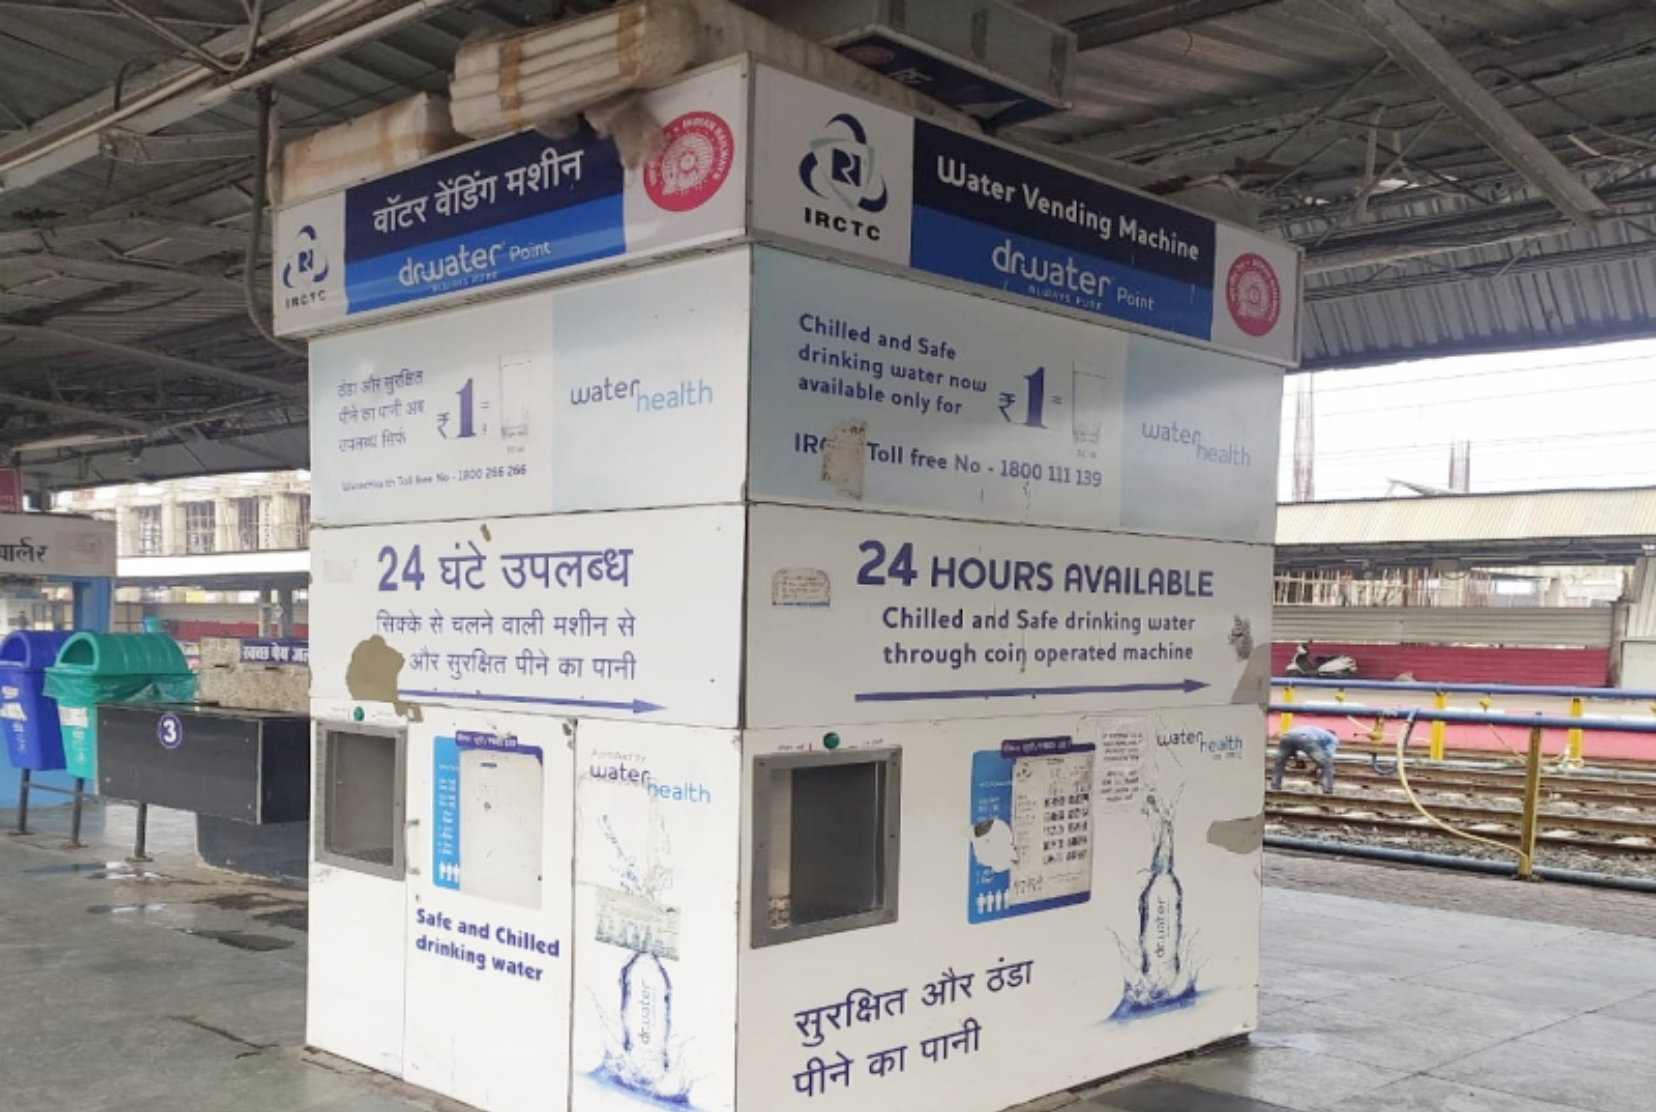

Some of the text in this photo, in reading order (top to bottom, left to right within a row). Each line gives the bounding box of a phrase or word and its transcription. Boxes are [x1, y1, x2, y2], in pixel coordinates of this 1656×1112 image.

[373, 147, 585, 235] वॉटर वेंडिंग मशीन
[936, 153, 1200, 262] Water Vending Machine
[803, 205, 882, 242] IRCTC
[509, 242, 551, 262] Point
[285, 289, 326, 309] IRCTC
[1117, 287, 1155, 311] Point
[799, 314, 957, 361] Chilled and Safe
[799, 344, 987, 393] drinking water now
[570, 376, 641, 406] water
[636, 379, 714, 414] health
[799, 376, 963, 416] available only for
[1141, 419, 1201, 446] water
[1195, 430, 1252, 468] health
[457, 467, 484, 482] 1800
[866, 441, 903, 465] Toll
[910, 446, 947, 471] free
[953, 450, 981, 473] No
[1000, 459, 1043, 480] 1800
[1048, 465, 1071, 483] 111
[1076, 470, 1102, 487] 139
[377, 540, 634, 592] 24 घंटे उपलब्ध
[856, 539, 918, 588] 24
[930, 556, 1055, 593] HOURS
[1063, 562, 1214, 598] AVAILABLE
[375, 608, 638, 638] सिक्के से चलने वाली मशीन से
[882, 606, 1196, 636] Chilled and Safe drinking water
[408, 645, 638, 681] और सुरक्षित पीने का पानी
[883, 643, 1193, 669] through coin operated machine
[162, 717, 177, 744] 3
[1156, 729, 1203, 747] water
[1200, 735, 1244, 754] health
[589, 762, 650, 786] water
[646, 780, 711, 804] health
[416, 907, 560, 958] Safe and Chilled
[415, 934, 544, 982] drinking water
[794, 957, 1034, 1049] सुरक्षित और ठंडा
[792, 1018, 983, 1100] पीने का पानी
